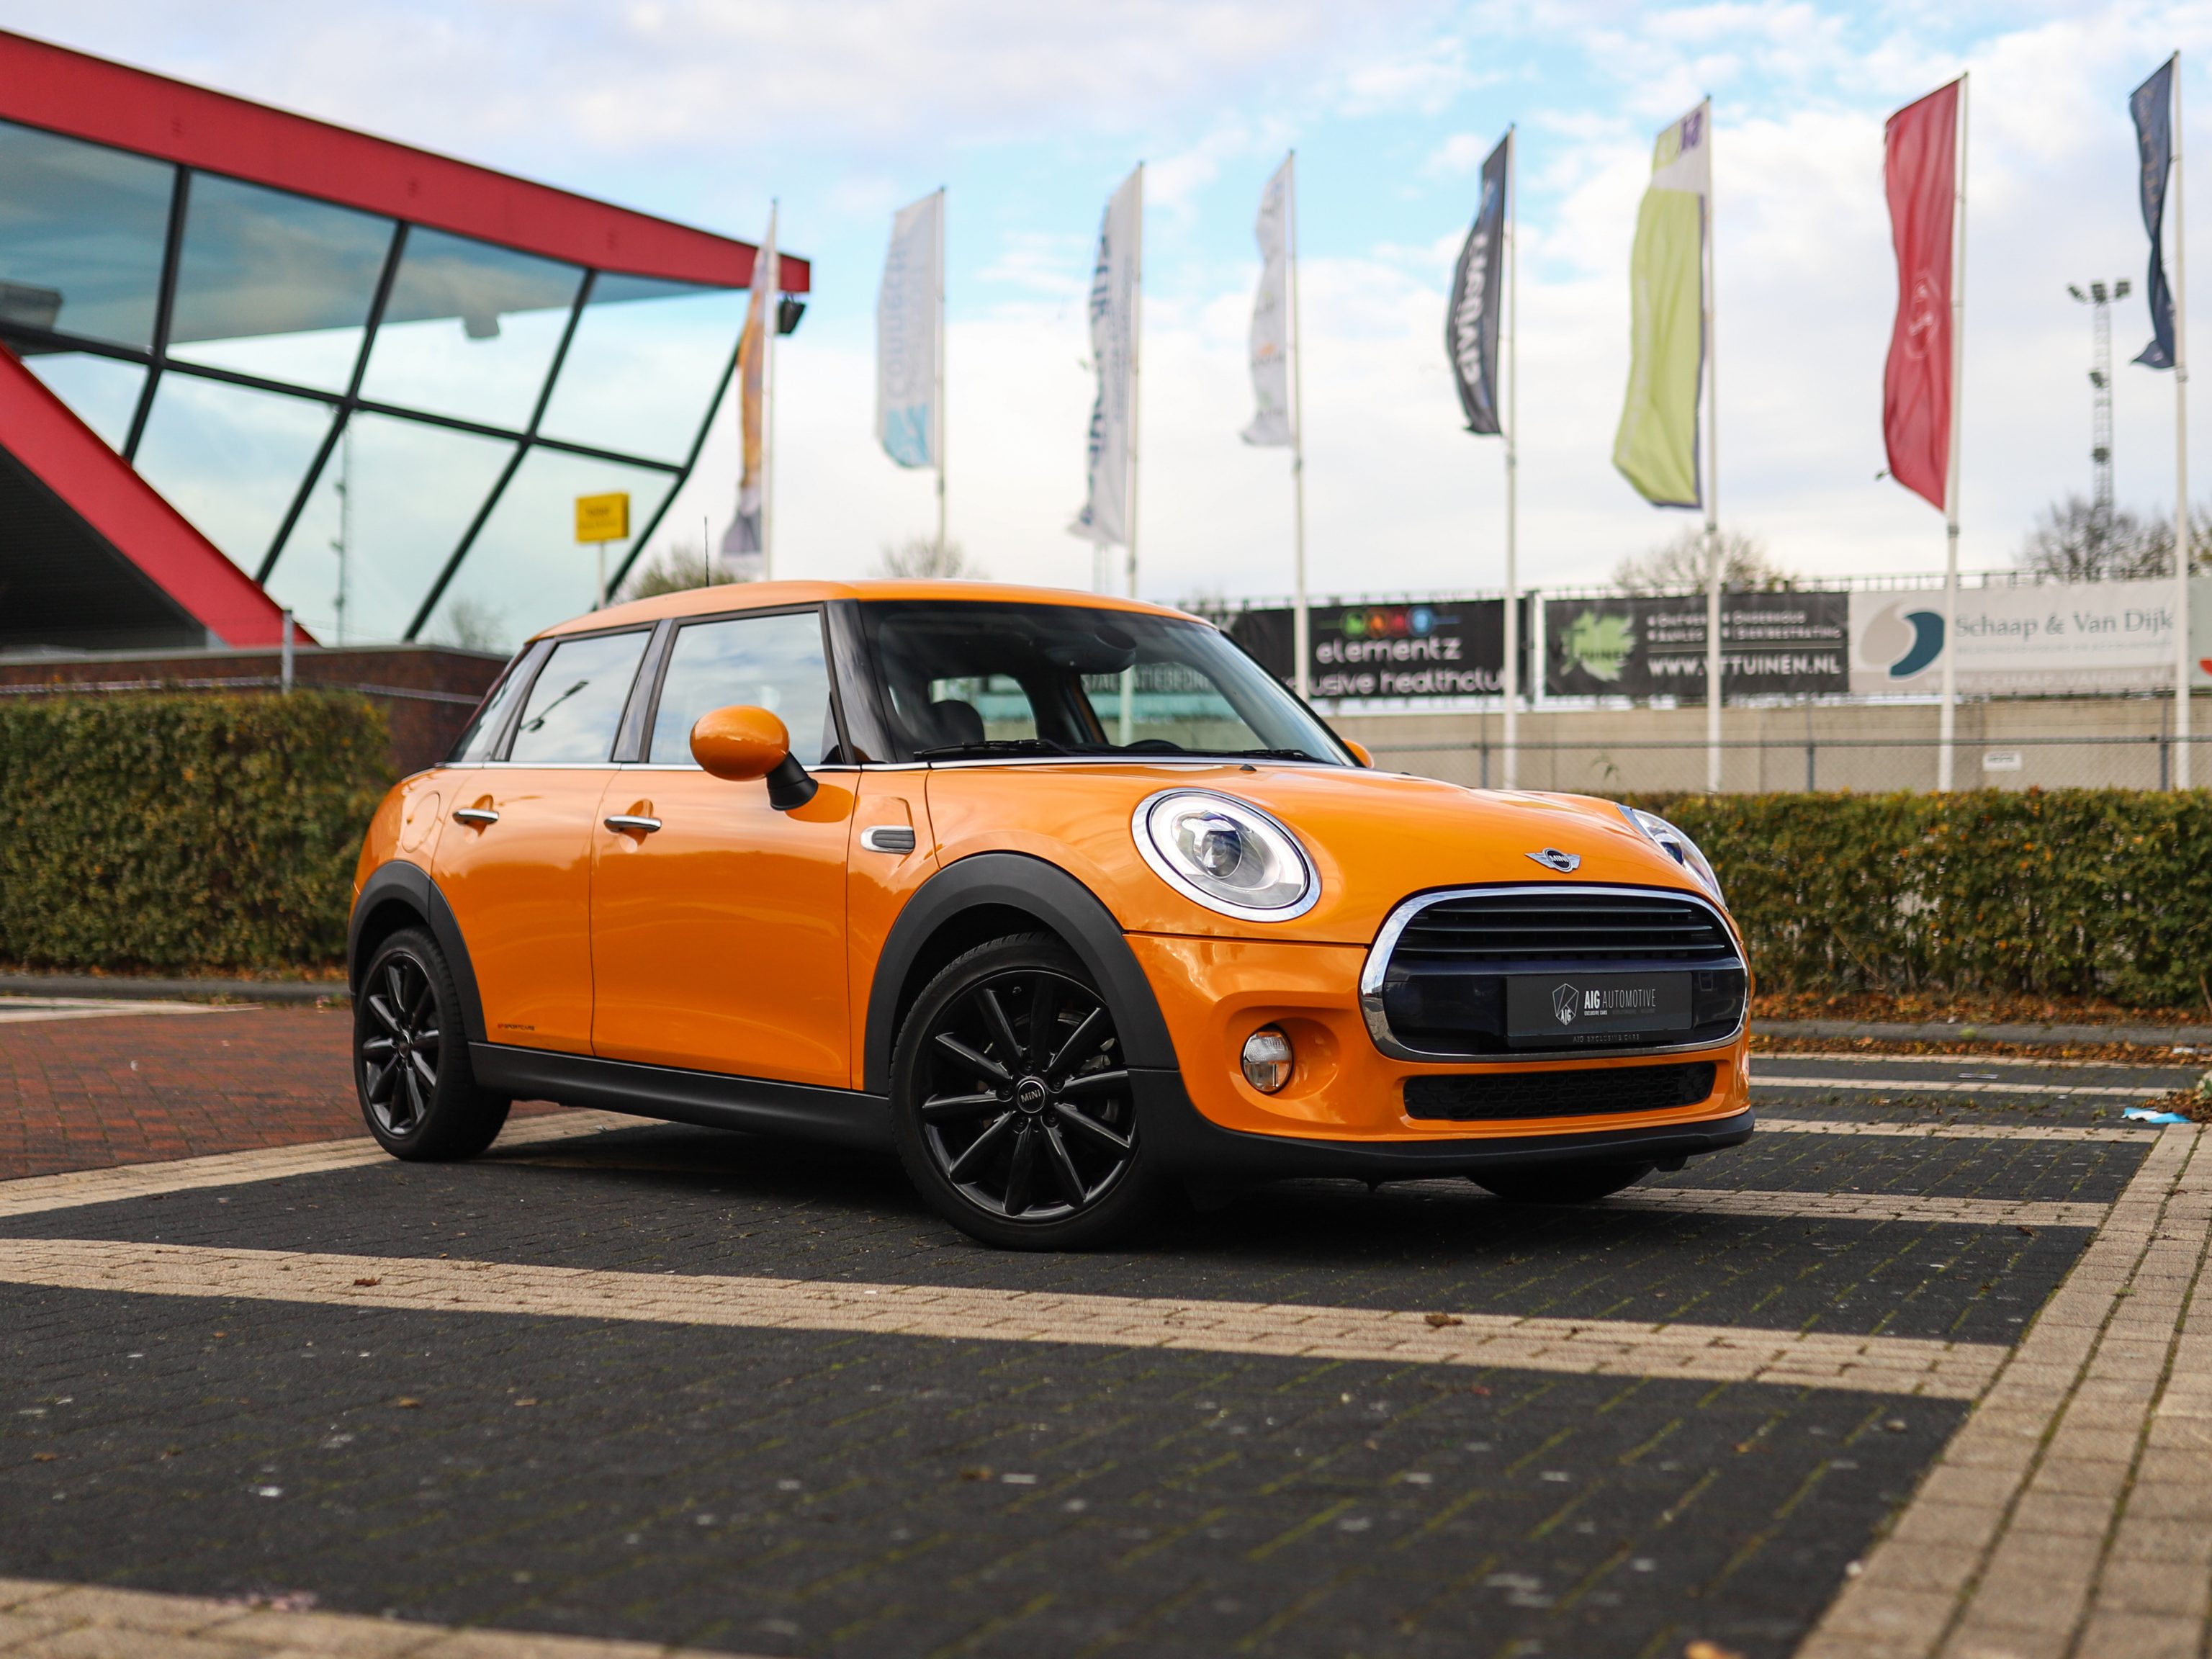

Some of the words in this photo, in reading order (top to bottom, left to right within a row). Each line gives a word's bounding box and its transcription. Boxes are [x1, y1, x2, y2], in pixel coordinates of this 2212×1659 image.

[1955, 613, 2038, 641] Schaap
[2045, 613, 2064, 636] &
[2073, 611, 2116, 634] Van
[2125, 607, 2173, 636] Dijk
[1316, 637, 1462, 664] elementz
[1380, 666, 1506, 693] healthclu
[1583, 989, 1601, 1010] AIG
[1602, 989, 1656, 1009] AUTOMOTIVE
[1561, 1009, 1571, 1024] AIG
[1020, 1089, 1041, 1103] MINI
